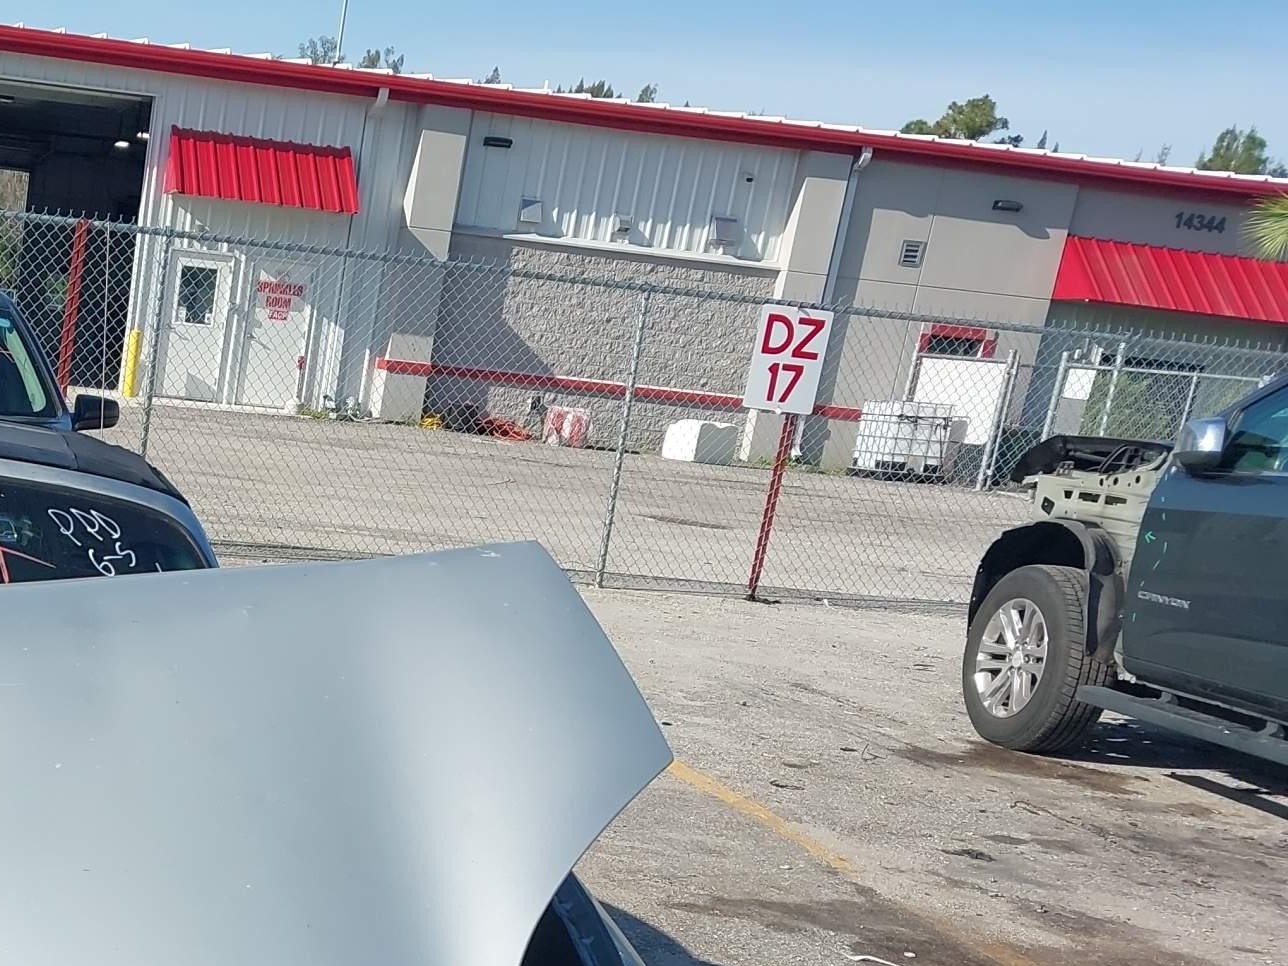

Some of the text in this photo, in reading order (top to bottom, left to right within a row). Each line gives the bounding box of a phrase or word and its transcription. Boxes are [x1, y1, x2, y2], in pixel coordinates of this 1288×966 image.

[1175, 211, 1226, 233] 14344
[761, 313, 827, 360] DZ
[768, 362, 805, 403] 17
